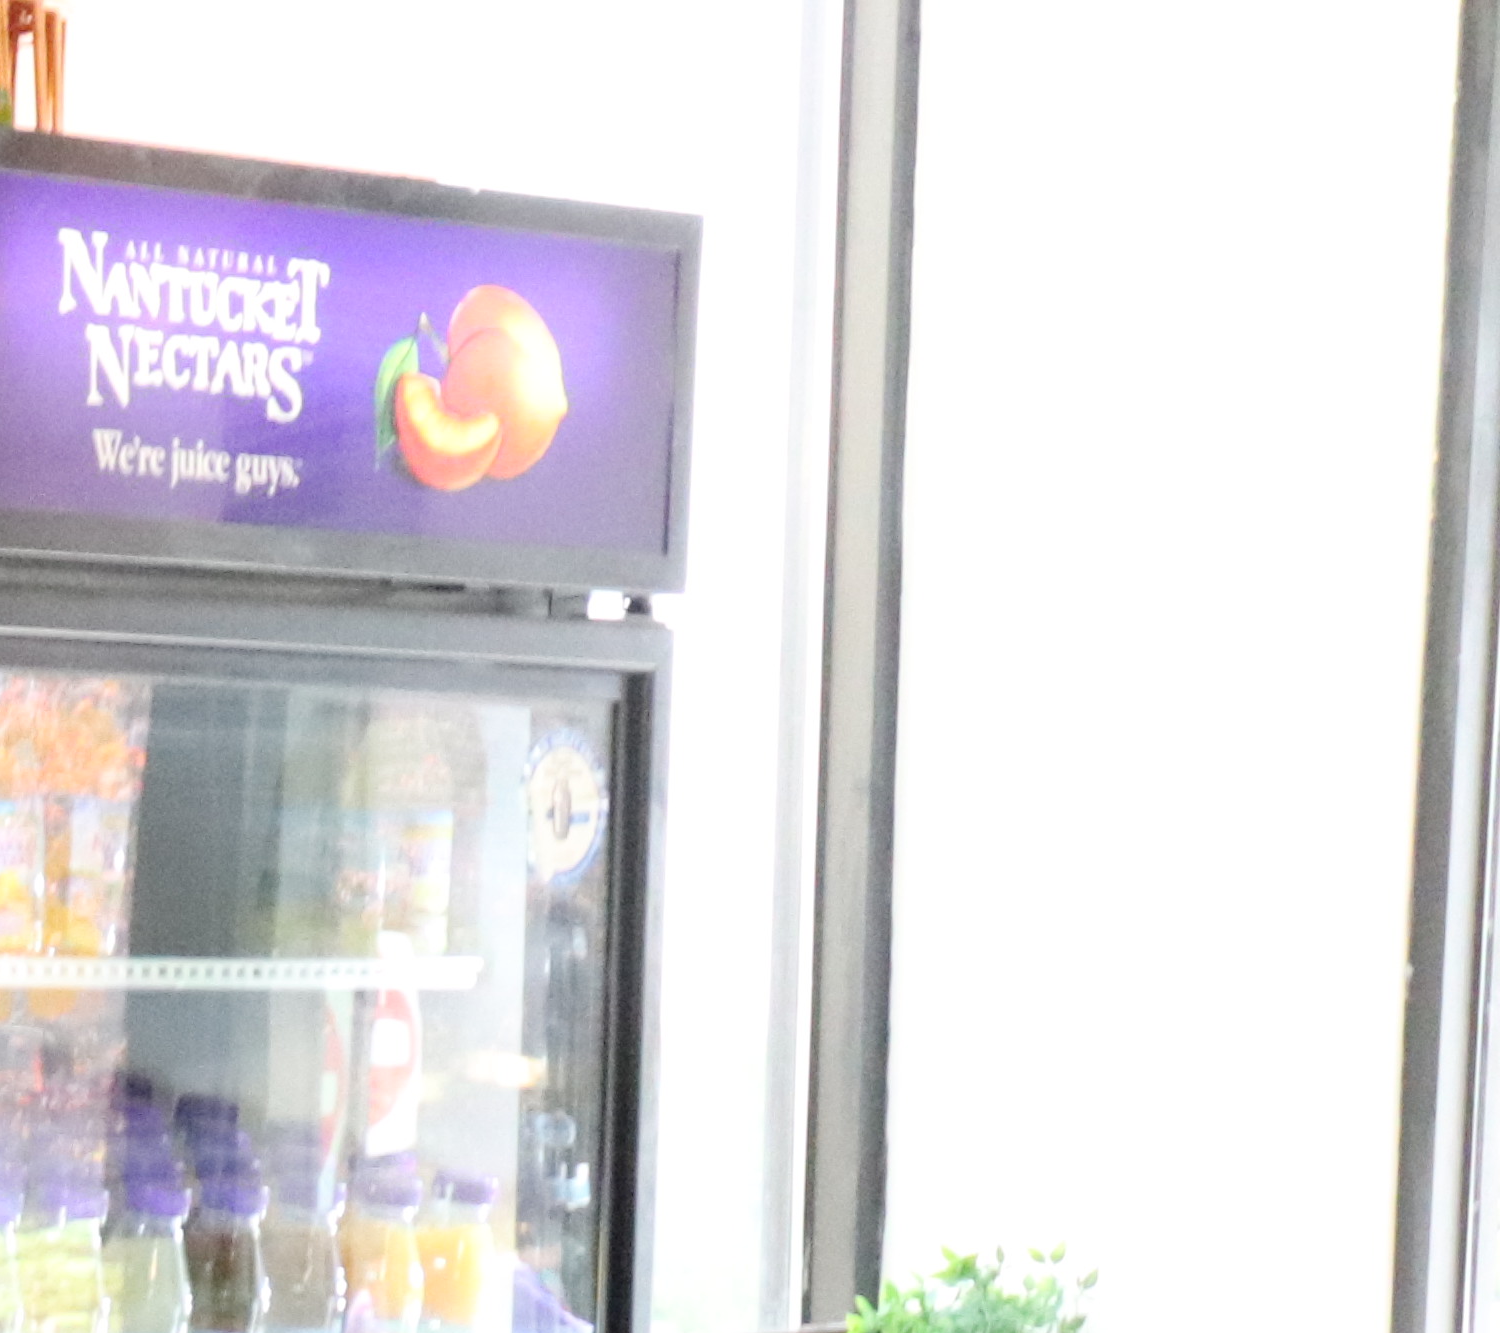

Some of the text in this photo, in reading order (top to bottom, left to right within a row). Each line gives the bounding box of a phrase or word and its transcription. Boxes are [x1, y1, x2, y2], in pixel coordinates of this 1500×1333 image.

[58, 227, 330, 344] NANTUCKET
[124, 239, 277, 276] ALL NATURAL
[85, 323, 303, 423] NECTARS
[92, 428, 167, 477] We're
[170, 436, 231, 489] juice
